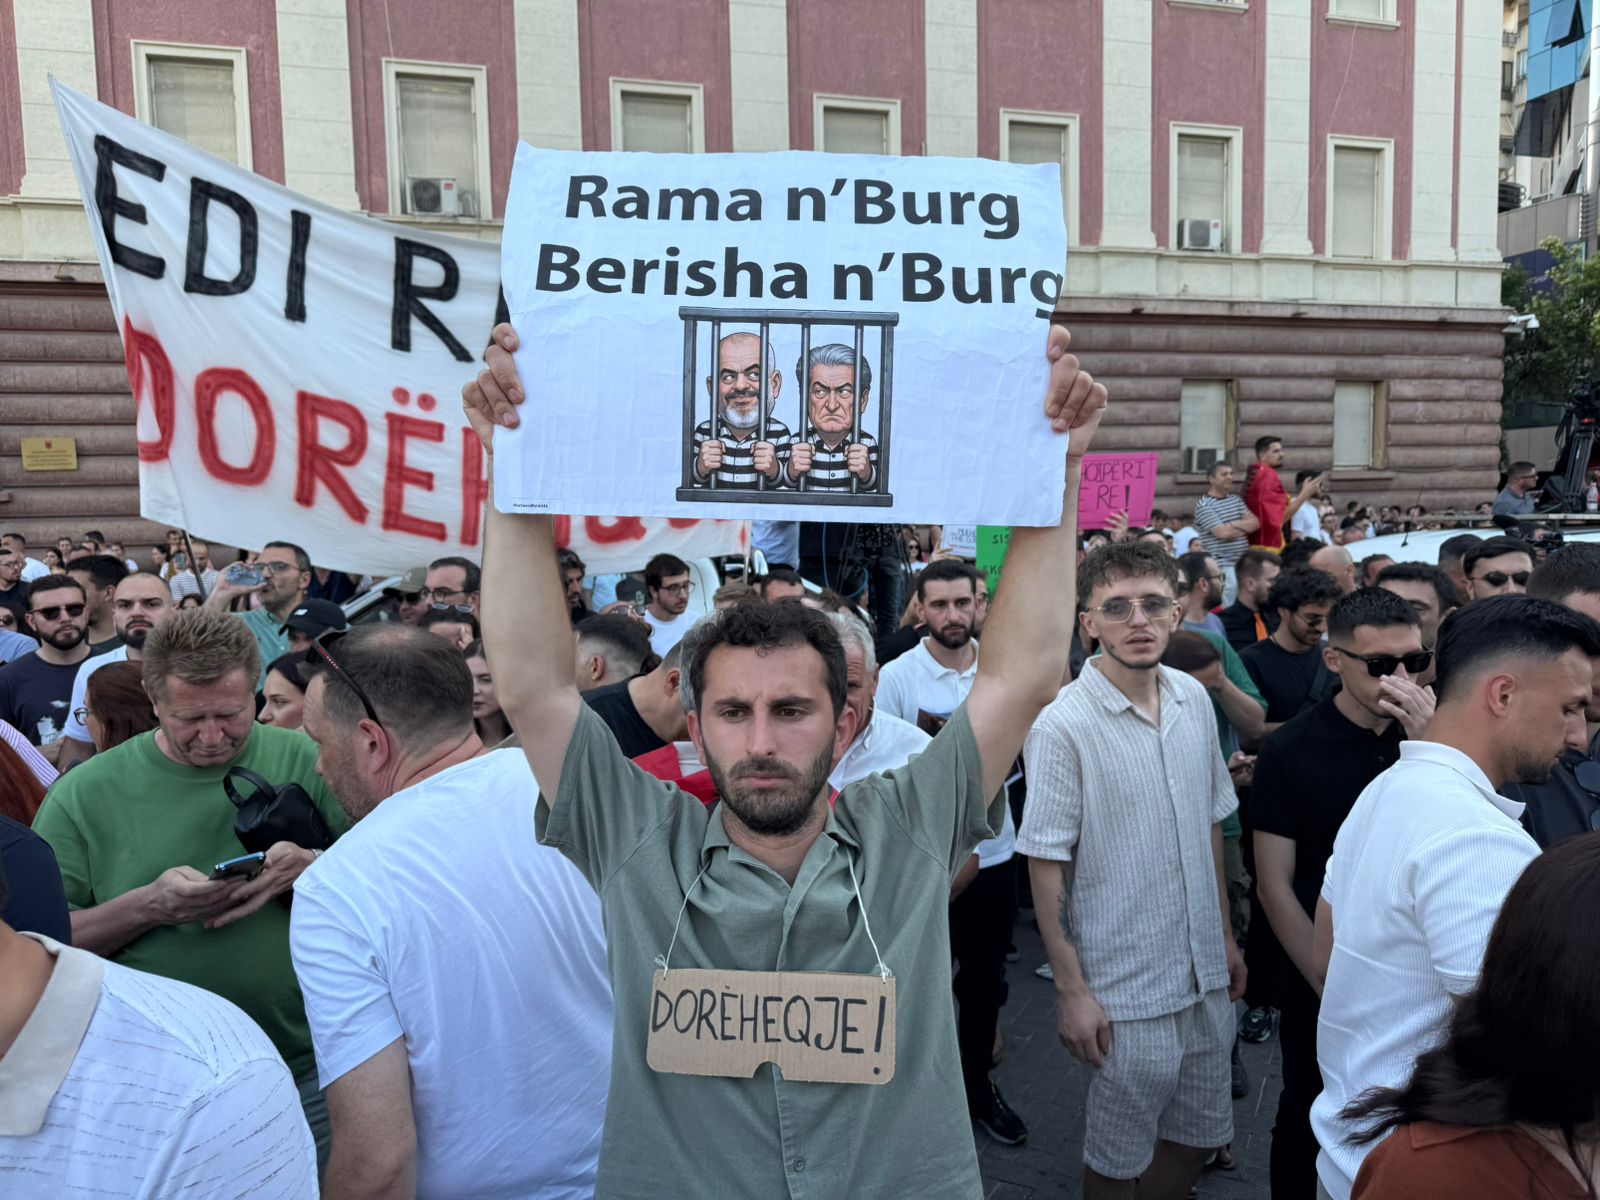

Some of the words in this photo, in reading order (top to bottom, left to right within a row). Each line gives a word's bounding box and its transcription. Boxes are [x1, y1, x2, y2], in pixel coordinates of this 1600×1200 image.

[565, 174, 763, 222] Rama
[94, 134, 312, 323] EDI
[391, 236, 509, 363] R
[535, 243, 808, 299] Berisha
